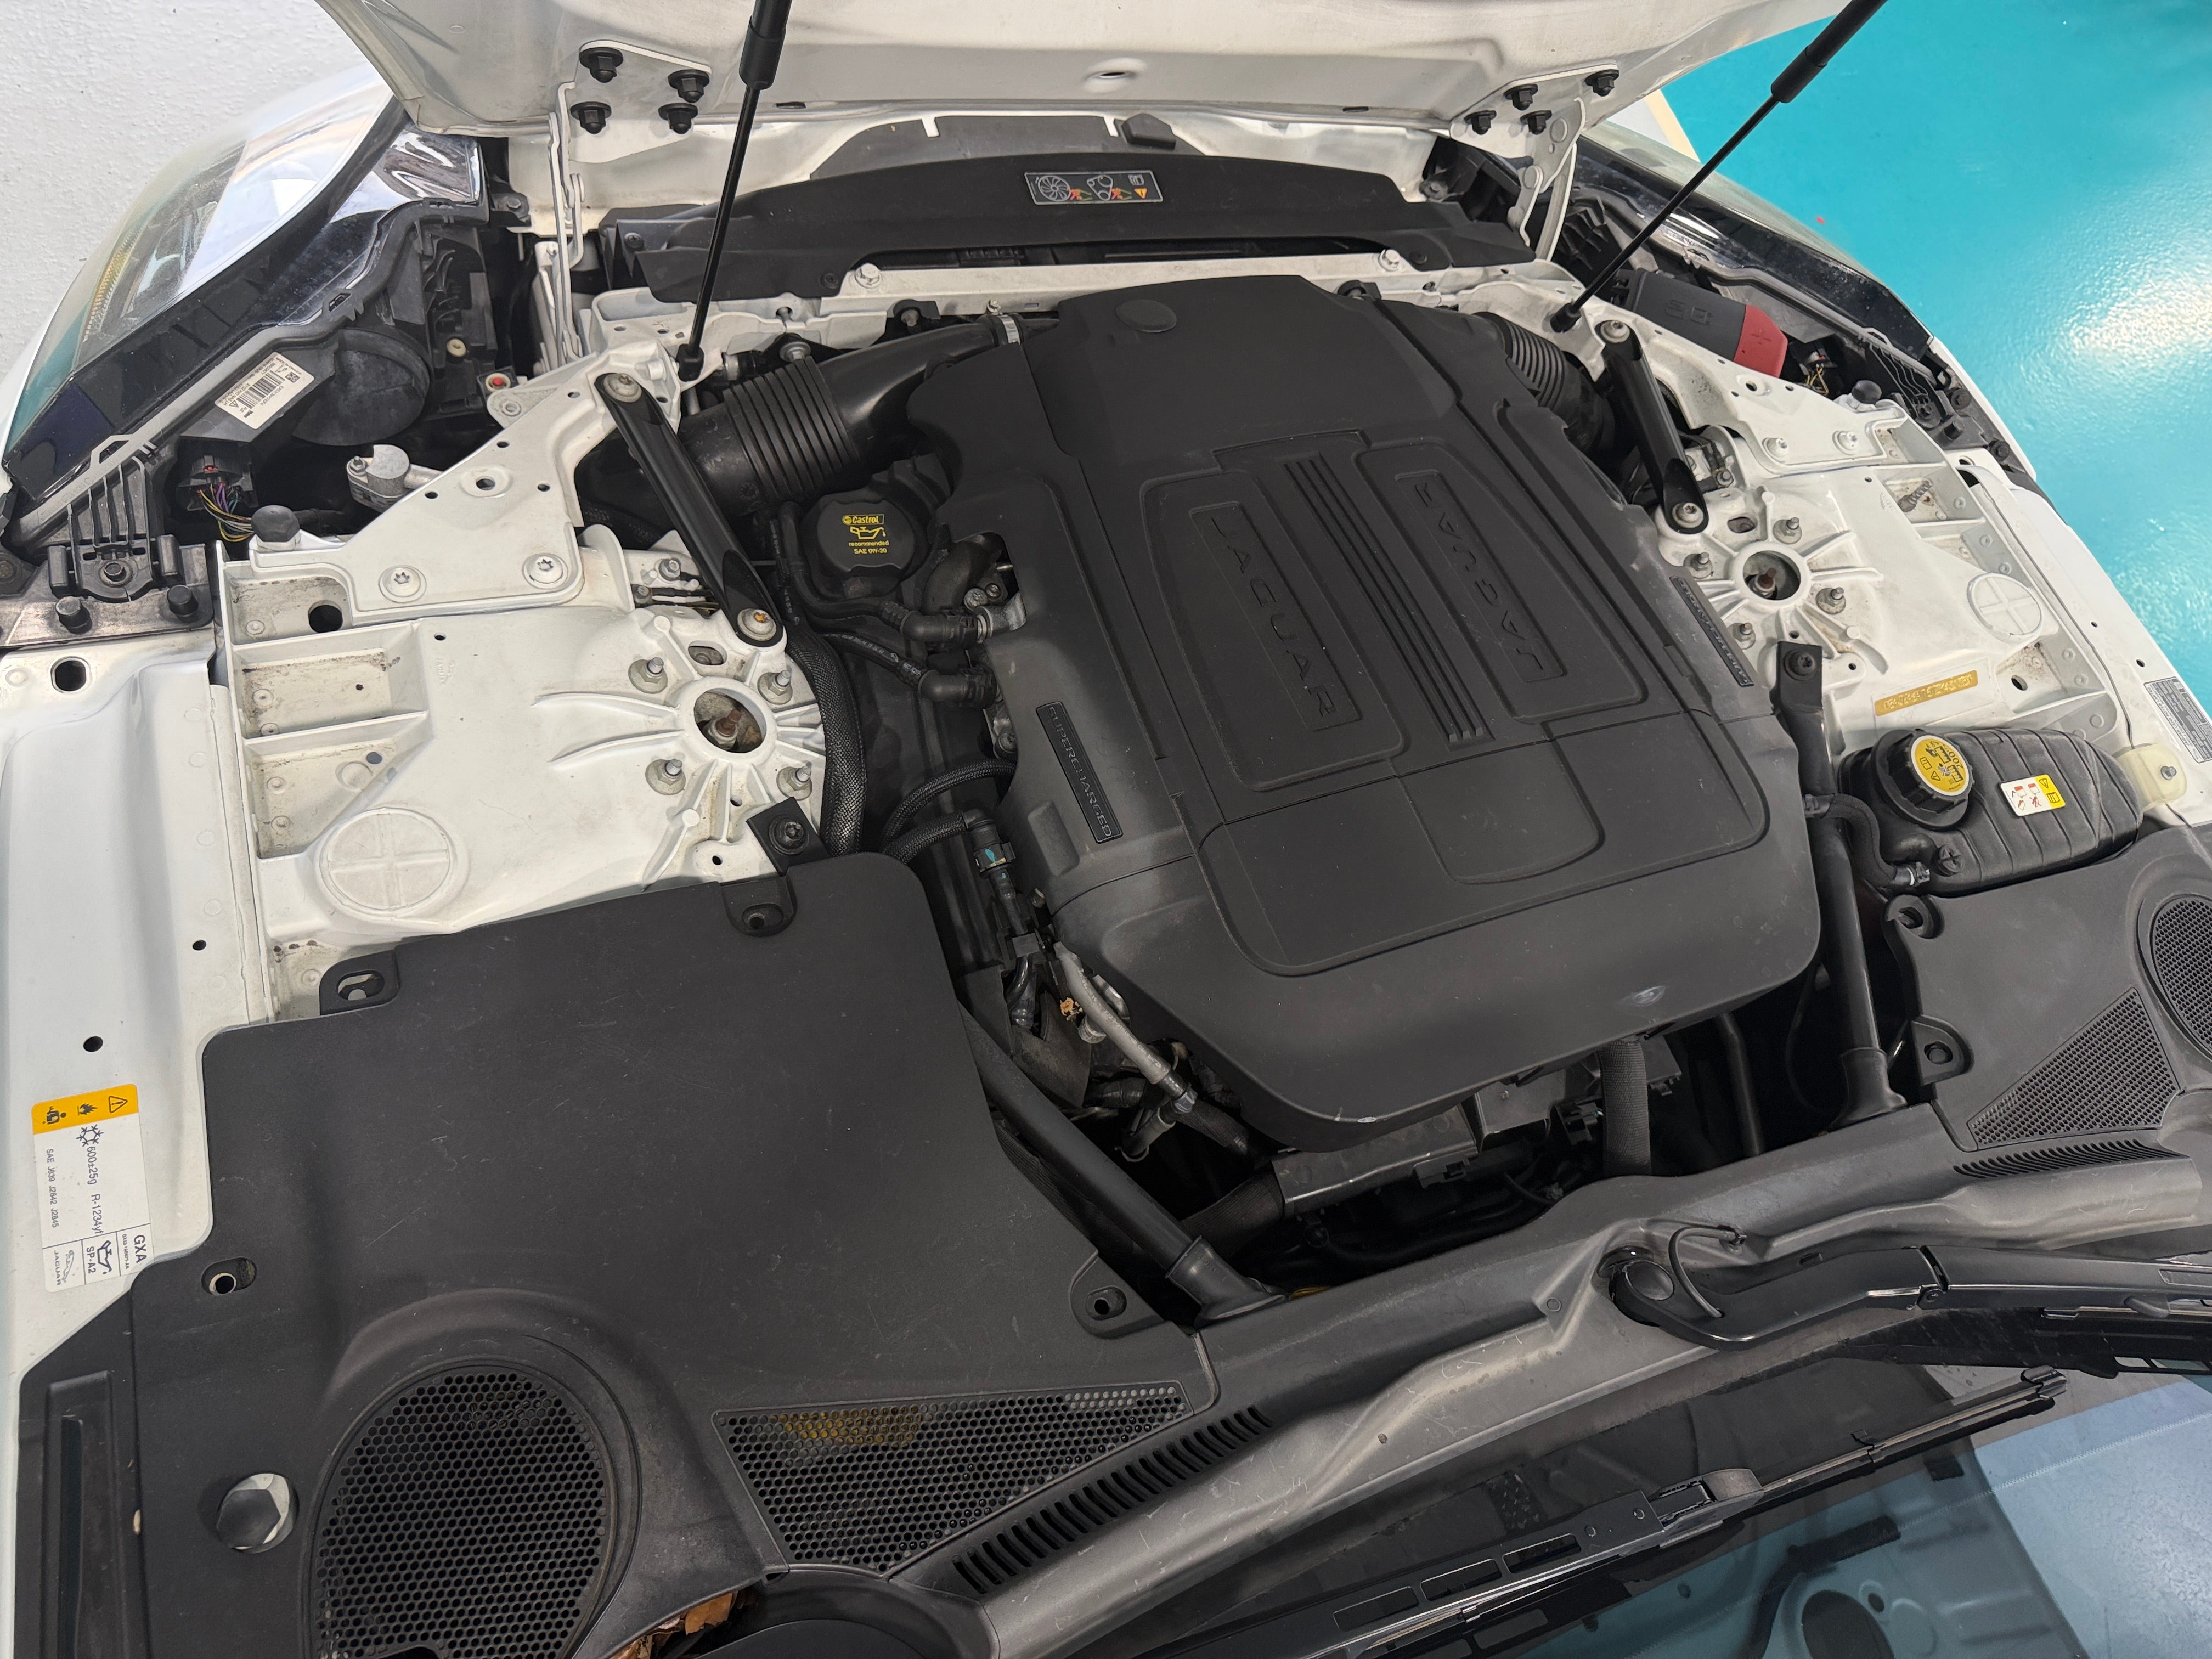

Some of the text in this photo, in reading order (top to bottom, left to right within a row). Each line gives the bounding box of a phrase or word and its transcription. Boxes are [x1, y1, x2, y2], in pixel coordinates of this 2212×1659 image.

[851, 515, 879, 524] Castrol
[1211, 516, 1337, 718] JAGUAR
[1048, 706, 1112, 837] SUPERCHARGED
[46, 1148, 54, 1164] SAE
[47, 1166, 55, 1182] J639
[49, 1185, 58, 1205] J2842
[87, 1146, 104, 1234] 600±25g R-1234yf
[86, 1246, 97, 1274] SP-A2
[134, 1234, 147, 1263] GXA
